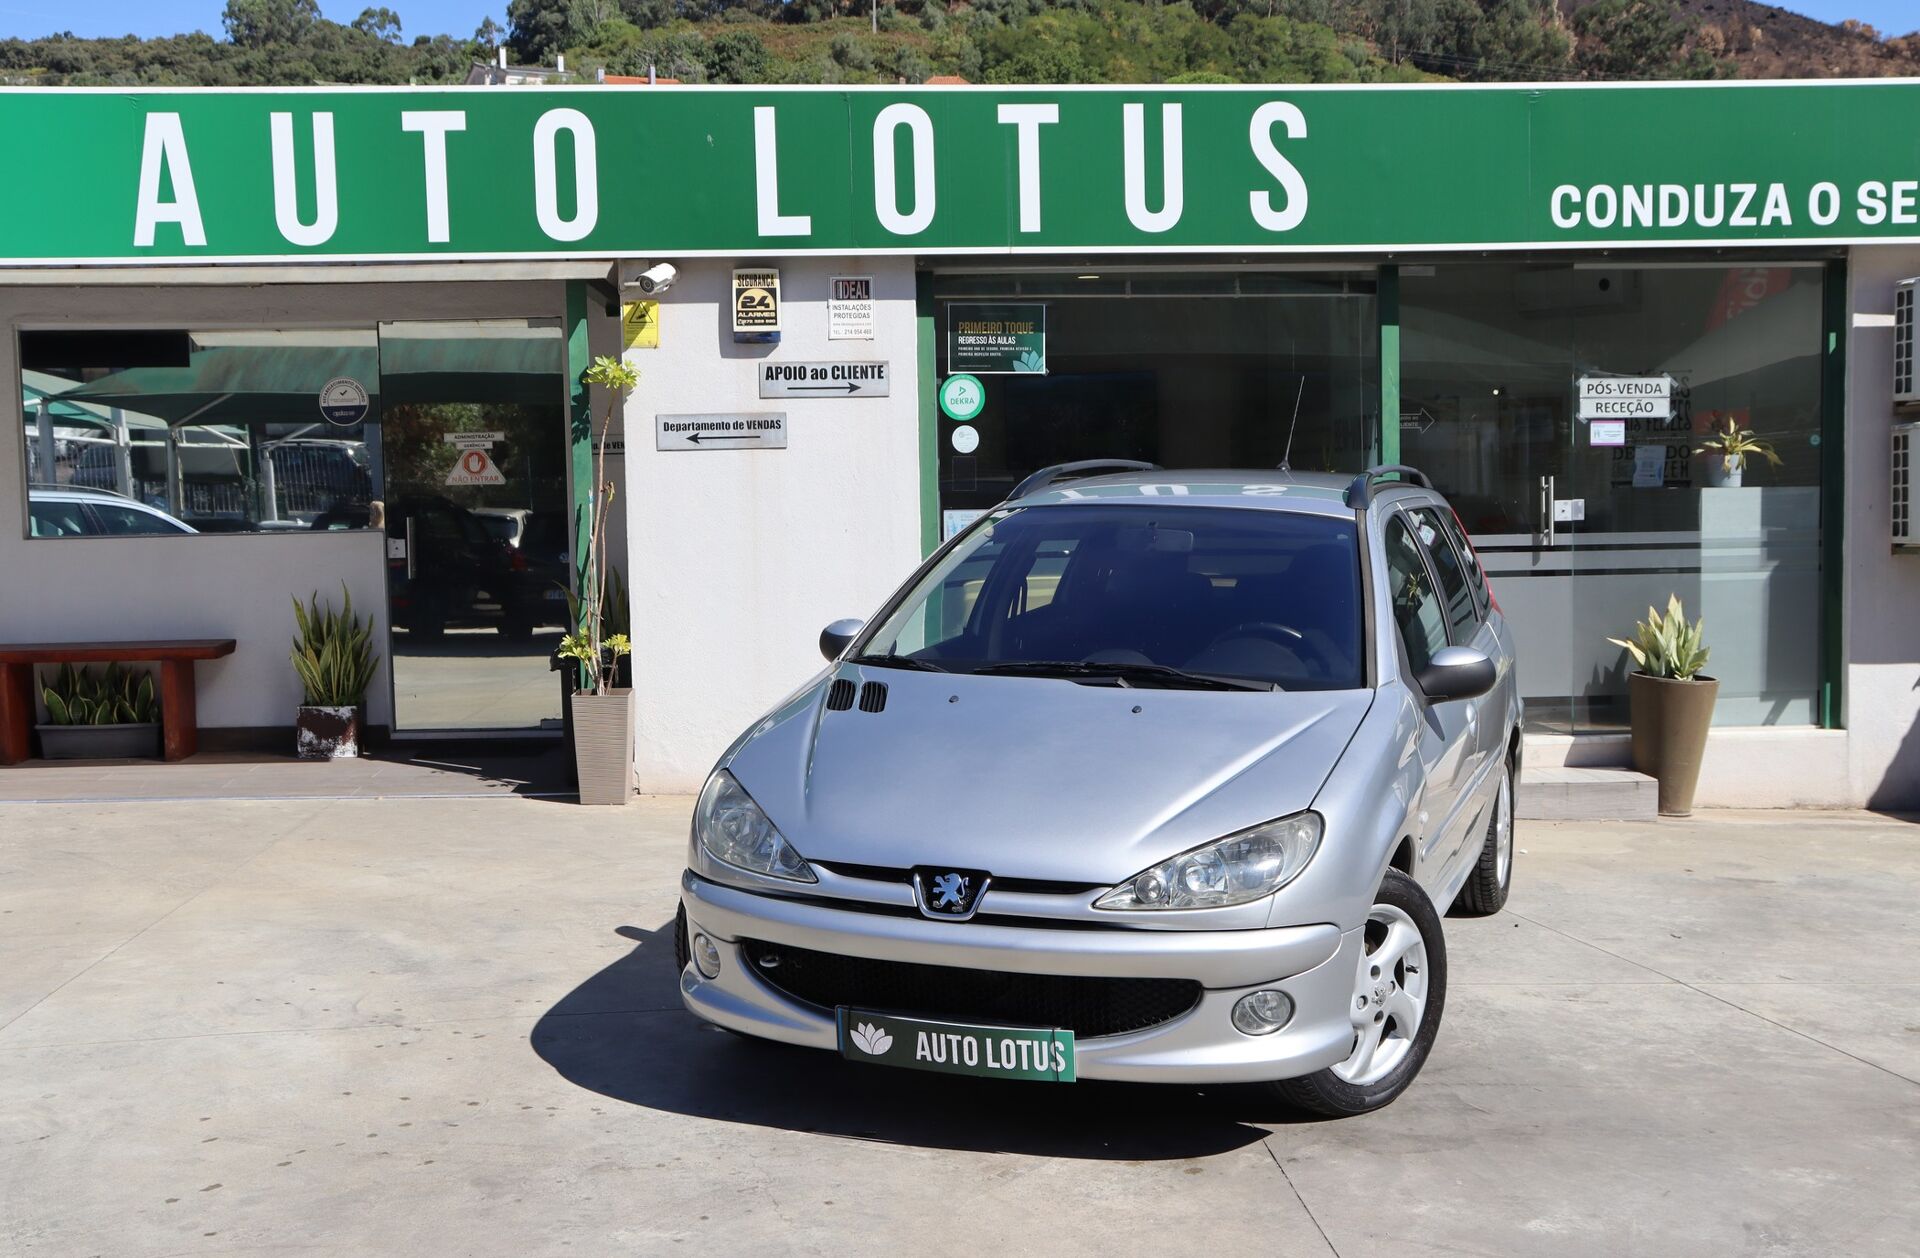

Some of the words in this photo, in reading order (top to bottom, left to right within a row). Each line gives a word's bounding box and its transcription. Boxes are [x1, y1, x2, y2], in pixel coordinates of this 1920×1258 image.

[135, 108, 598, 246] AUTO
[754, 101, 1308, 236] LOTUS
[1550, 183, 1792, 228] CONDUZA
[1809, 181, 1840, 226] O
[737, 274, 774, 289] SEGURANÇA
[741, 296, 770, 308] 24
[958, 321, 1002, 334] PRIMEIRO
[1004, 321, 1035, 334] TOQUE
[958, 336, 988, 344] REGRESSO
[997, 336, 1016, 344] AULAS
[765, 365, 807, 381] APOIO
[810, 367, 828, 380] ao
[831, 365, 884, 380] CLIENTE
[1587, 381, 1663, 395] PÓS-VENDA
[950, 397, 975, 405] DEKRA
[1595, 399, 1654, 416] RECEÇÃO
[663, 421, 731, 433] Departamento
[732, 420, 745, 431] de
[746, 419, 782, 430] VENDAS
[916, 1031, 978, 1066] AUTO
[985, 1037, 1066, 1073] LOTUS
